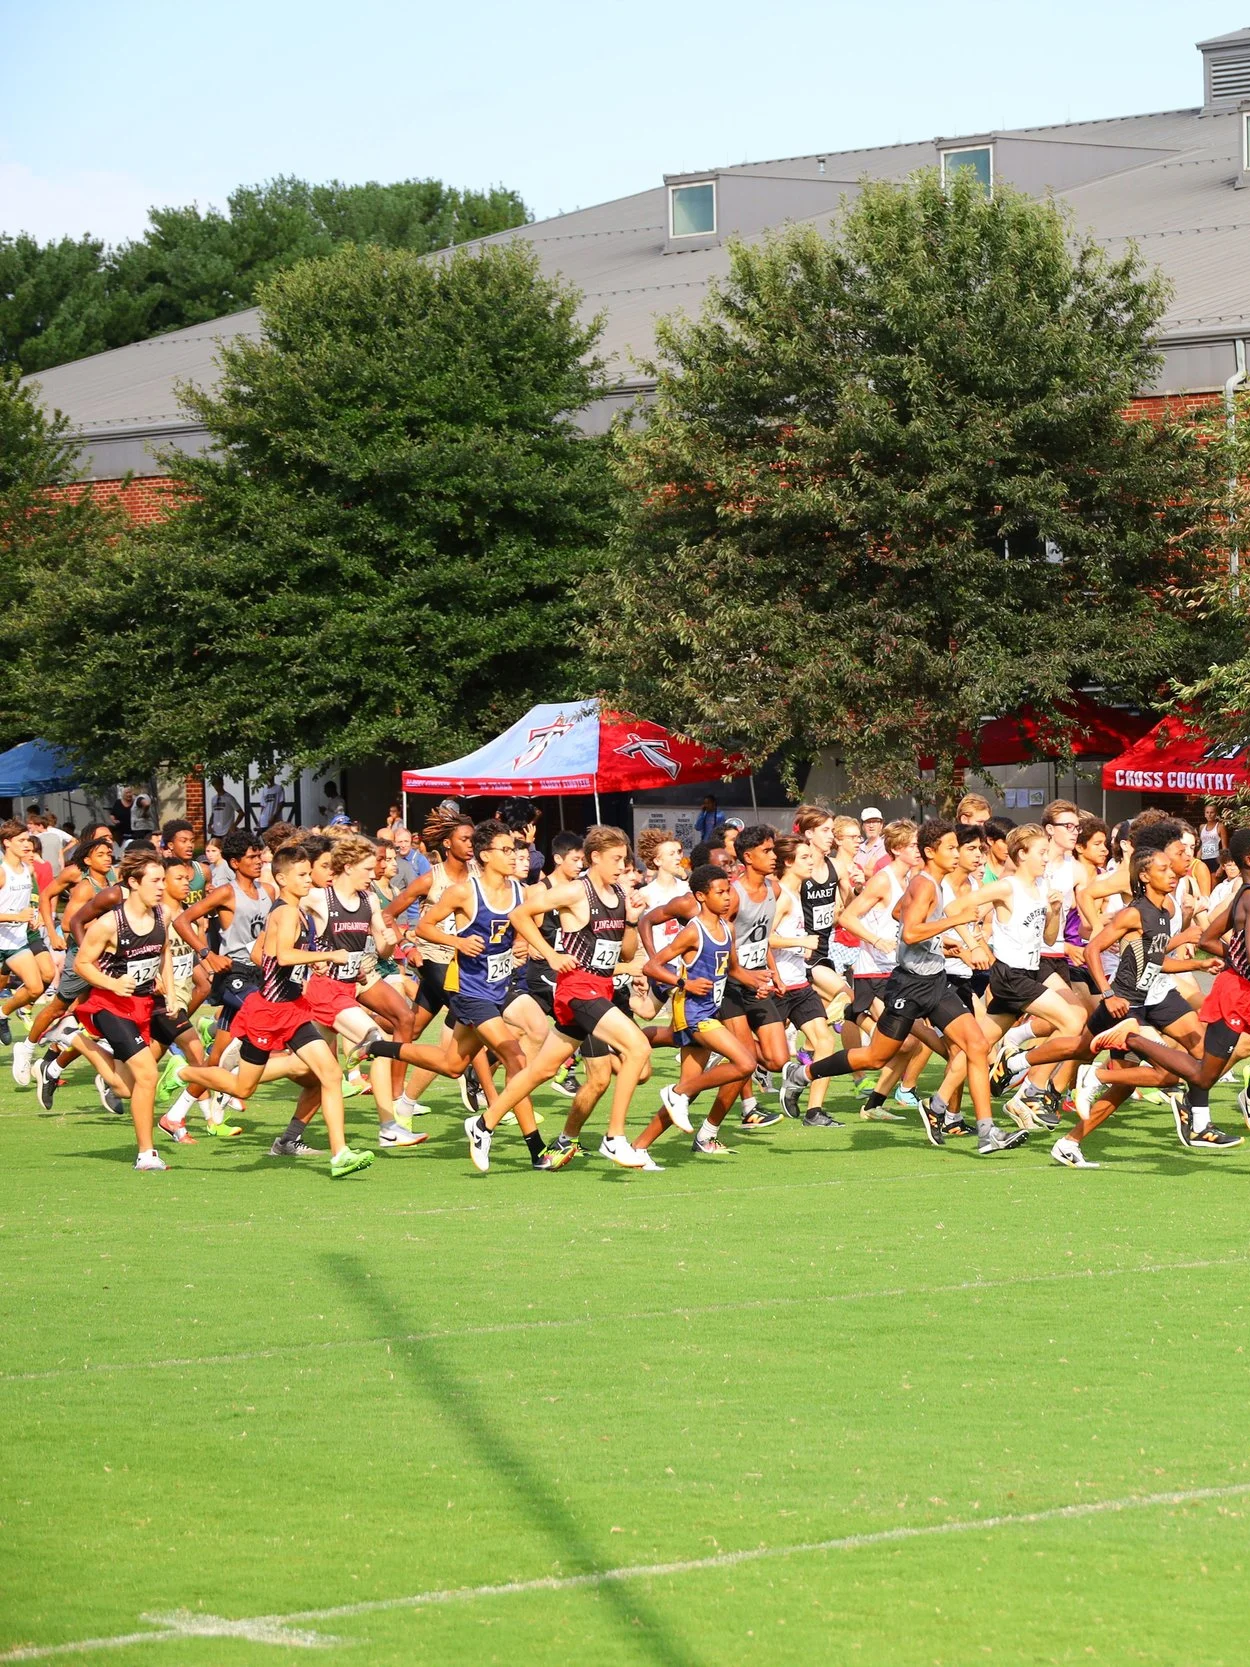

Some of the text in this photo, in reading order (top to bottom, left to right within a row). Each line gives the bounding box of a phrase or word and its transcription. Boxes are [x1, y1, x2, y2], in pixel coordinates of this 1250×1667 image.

[1115, 769, 1235, 790] CROSS COUNTRY
[807, 887, 835, 900] MARET
[489, 919, 511, 944] F
[491, 958, 510, 979] 248
[715, 951, 730, 976] F
[743, 948, 766, 968] 742
[133, 963, 160, 983] 427
